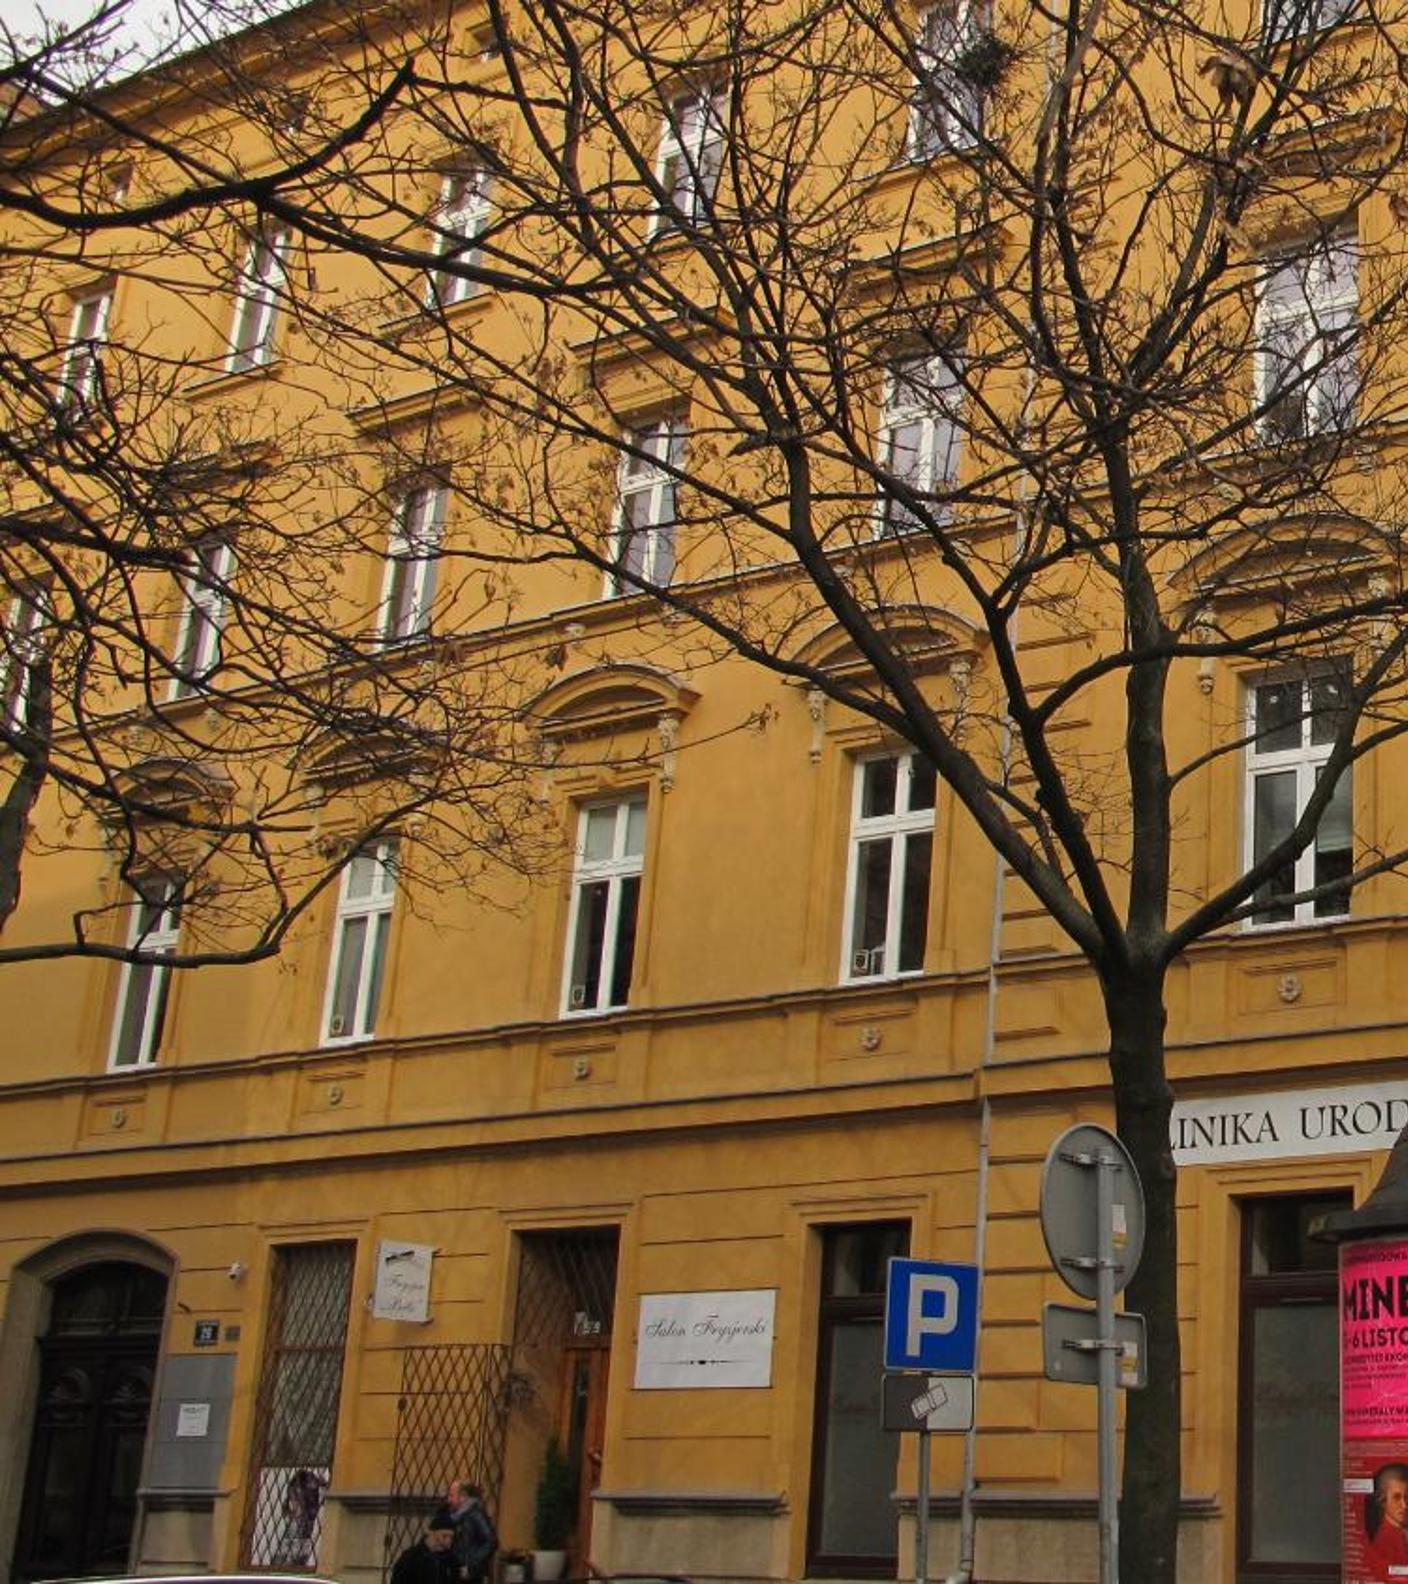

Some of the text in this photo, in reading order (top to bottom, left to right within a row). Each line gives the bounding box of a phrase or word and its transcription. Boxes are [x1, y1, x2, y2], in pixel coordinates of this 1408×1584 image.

[1171, 1110, 1279, 1150] INIKA
[645, 1320, 687, 1338] Salon
[906, 1273, 960, 1358] P
